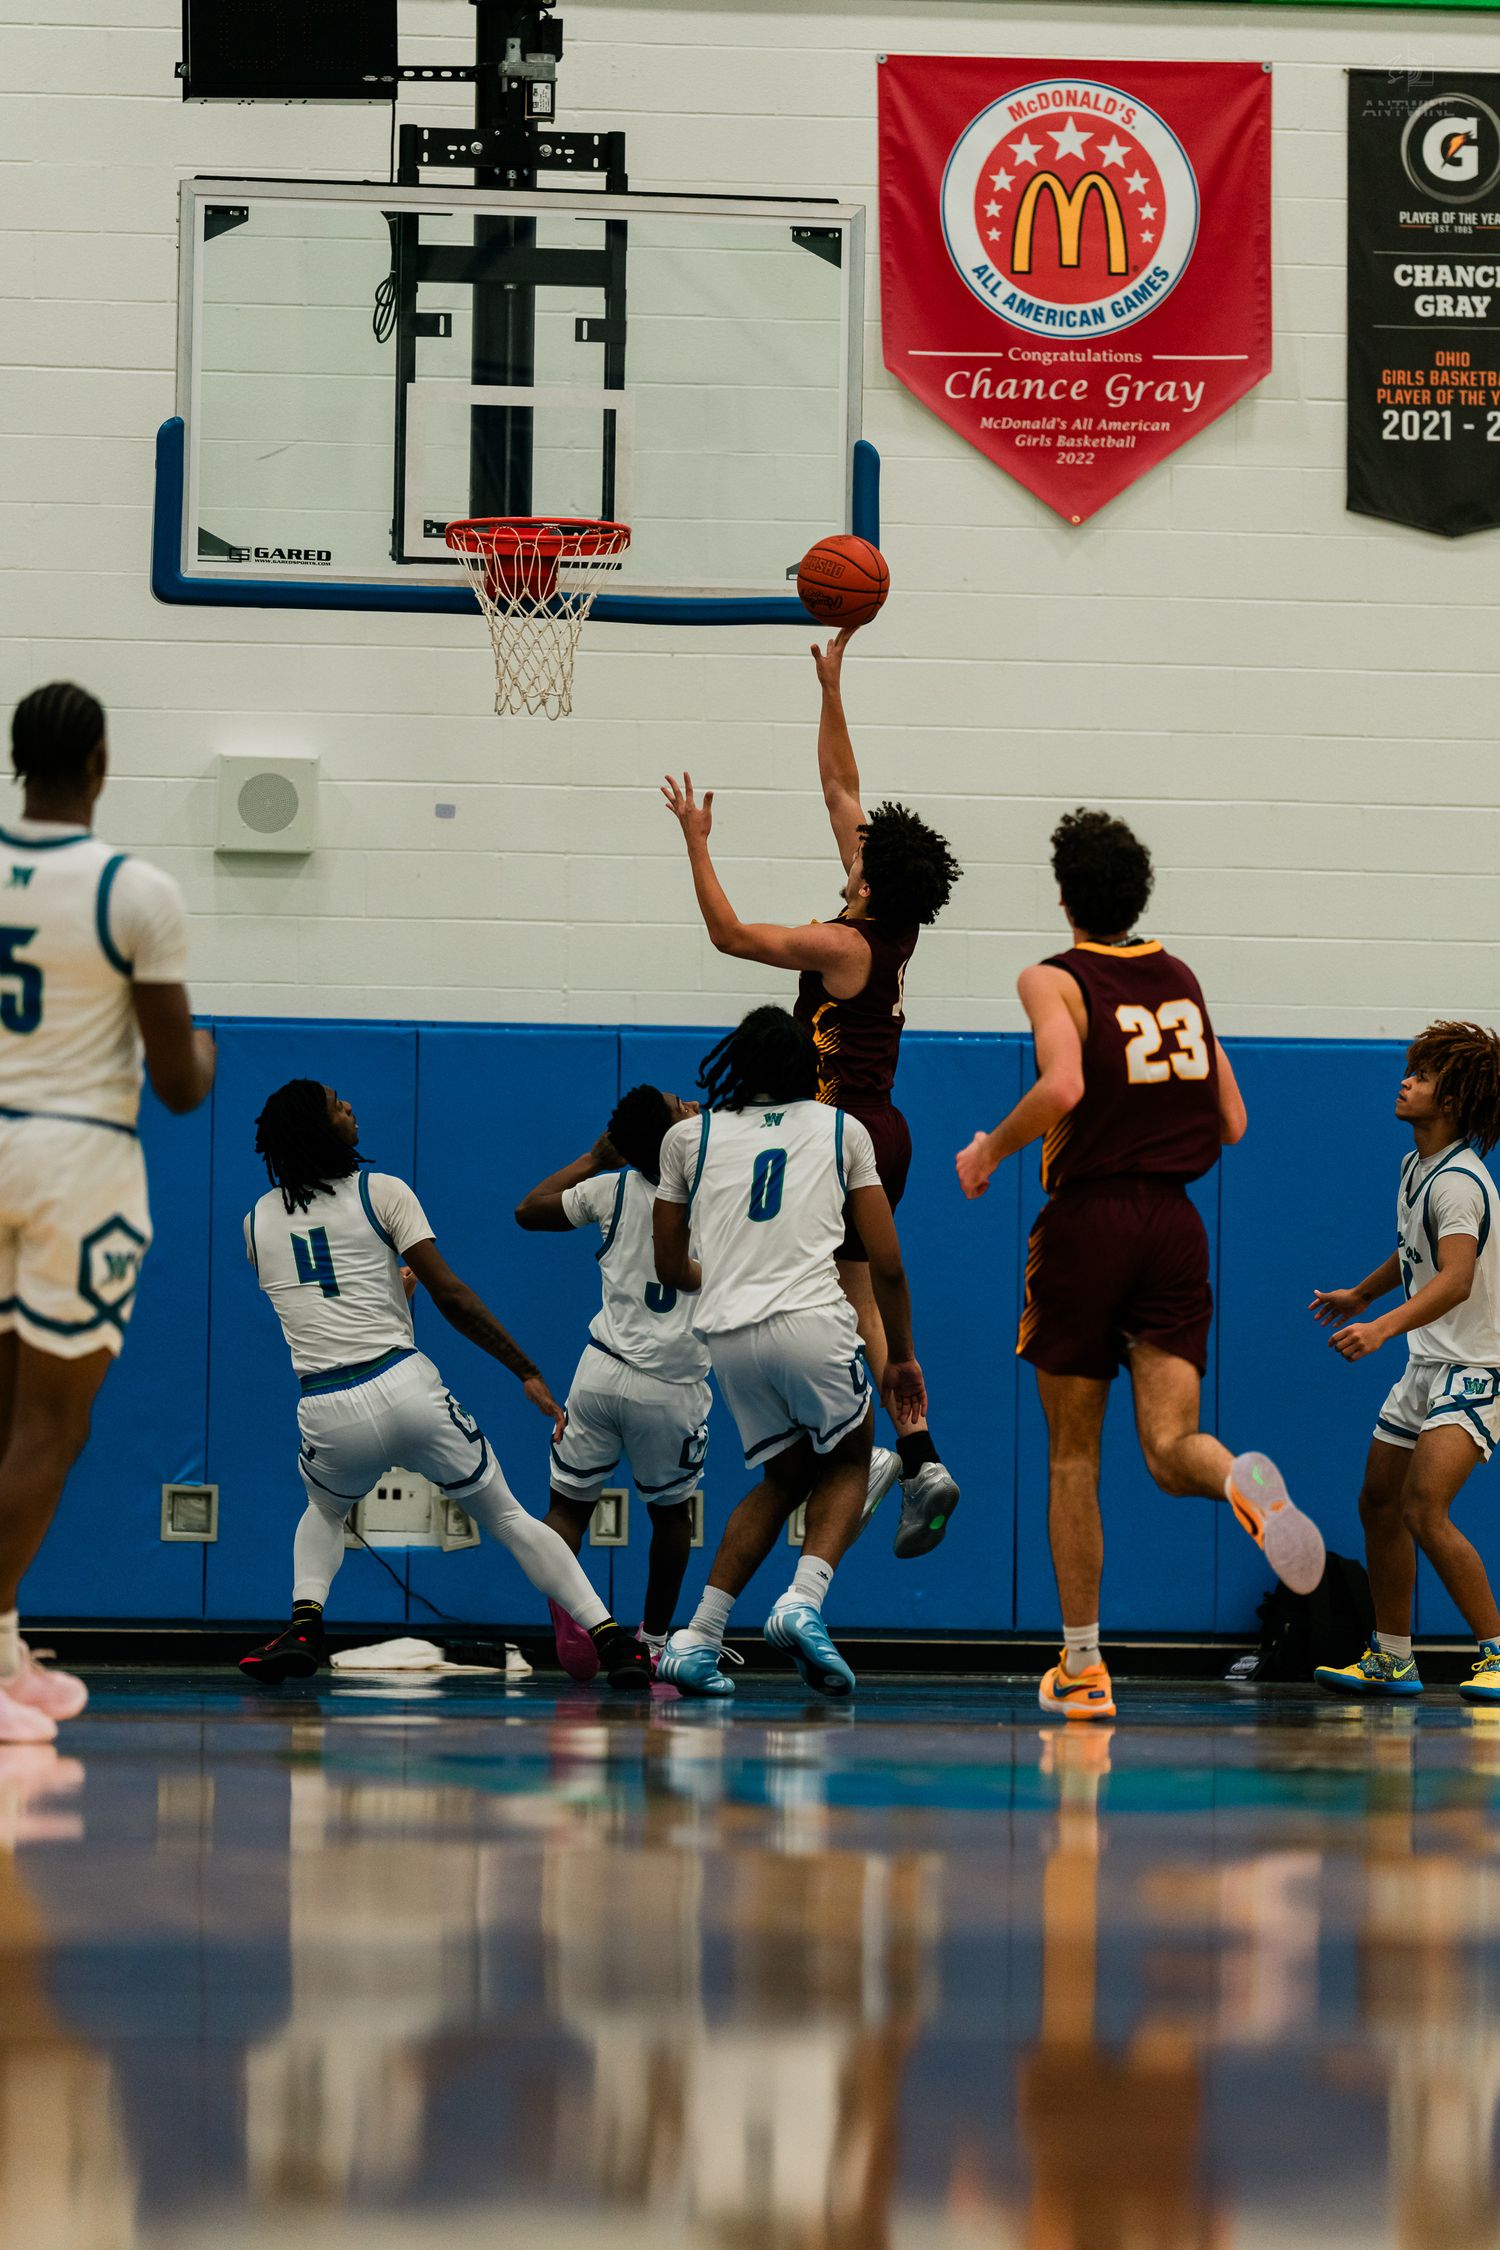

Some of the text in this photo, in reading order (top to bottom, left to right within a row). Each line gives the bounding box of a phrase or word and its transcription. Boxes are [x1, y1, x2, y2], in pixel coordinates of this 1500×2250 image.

[1007, 89, 1137, 126] McDONALD'S
[1399, 211, 1439, 224] PLAYER
[1442, 211, 1456, 224] OF
[1458, 212, 1478, 225] THE
[972, 264, 1170, 328] ALL AMERICAN GAMES
[1414, 294, 1492, 318] GRAY
[1008, 347, 1143, 365] Congratulations
[1435, 351, 1470, 367] OHIO
[1382, 369, 1425, 386] GIRLS
[944, 367, 1206, 413] Chance Gray
[1377, 388, 1431, 405] PLAYER
[1436, 389, 1454, 405] OF
[1459, 390, 1486, 406] THE
[979, 416, 1170, 432] McDonald's All American
[1382, 410, 1452, 441] 2021
[1015, 434, 1136, 449] Girls Basketball
[1056, 452, 1095, 465] 2022
[254, 547, 331, 561] GARED
[0, 924, 43, 1036] 5
[1114, 998, 1210, 1084] 23
[747, 1148, 788, 1222] 0
[290, 1226, 341, 1298] 4
